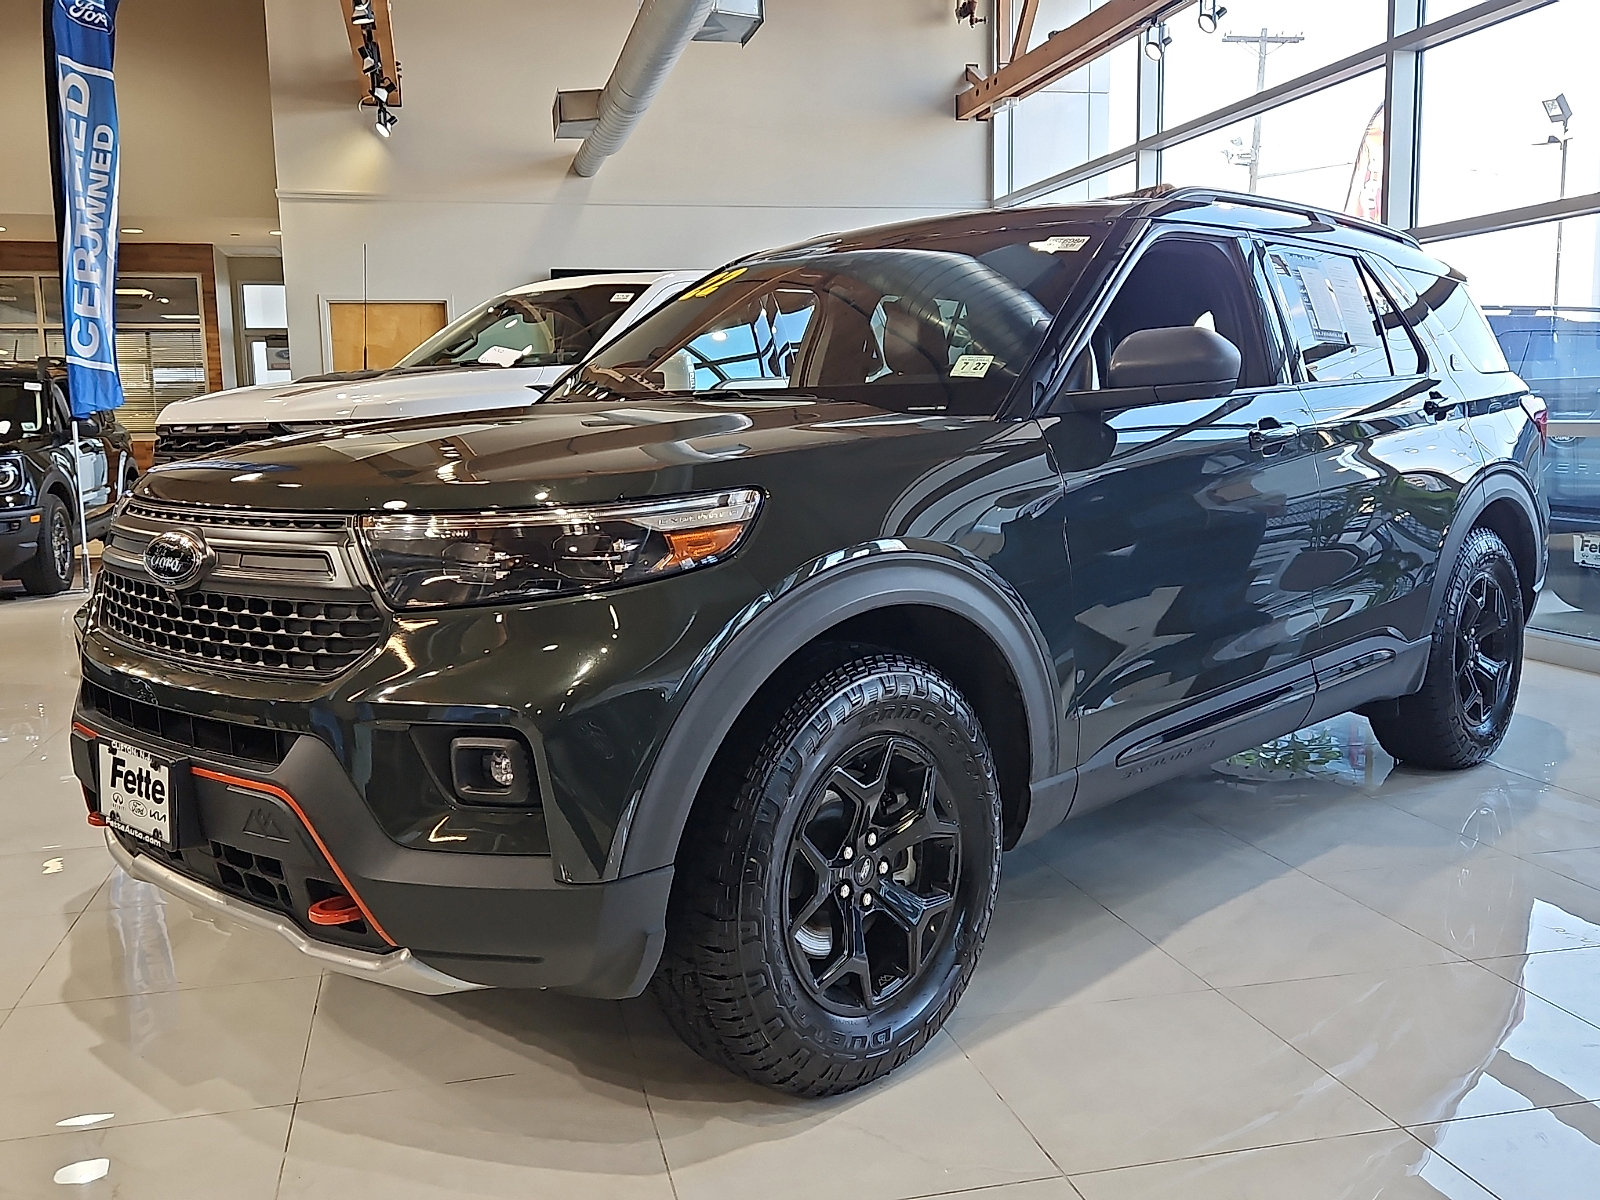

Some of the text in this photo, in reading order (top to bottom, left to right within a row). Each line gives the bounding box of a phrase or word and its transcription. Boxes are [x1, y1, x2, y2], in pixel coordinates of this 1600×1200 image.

[63, 72, 100, 358] CERTIED
[973, 361, 988, 371] 27
[110, 756, 165, 804] Fette
